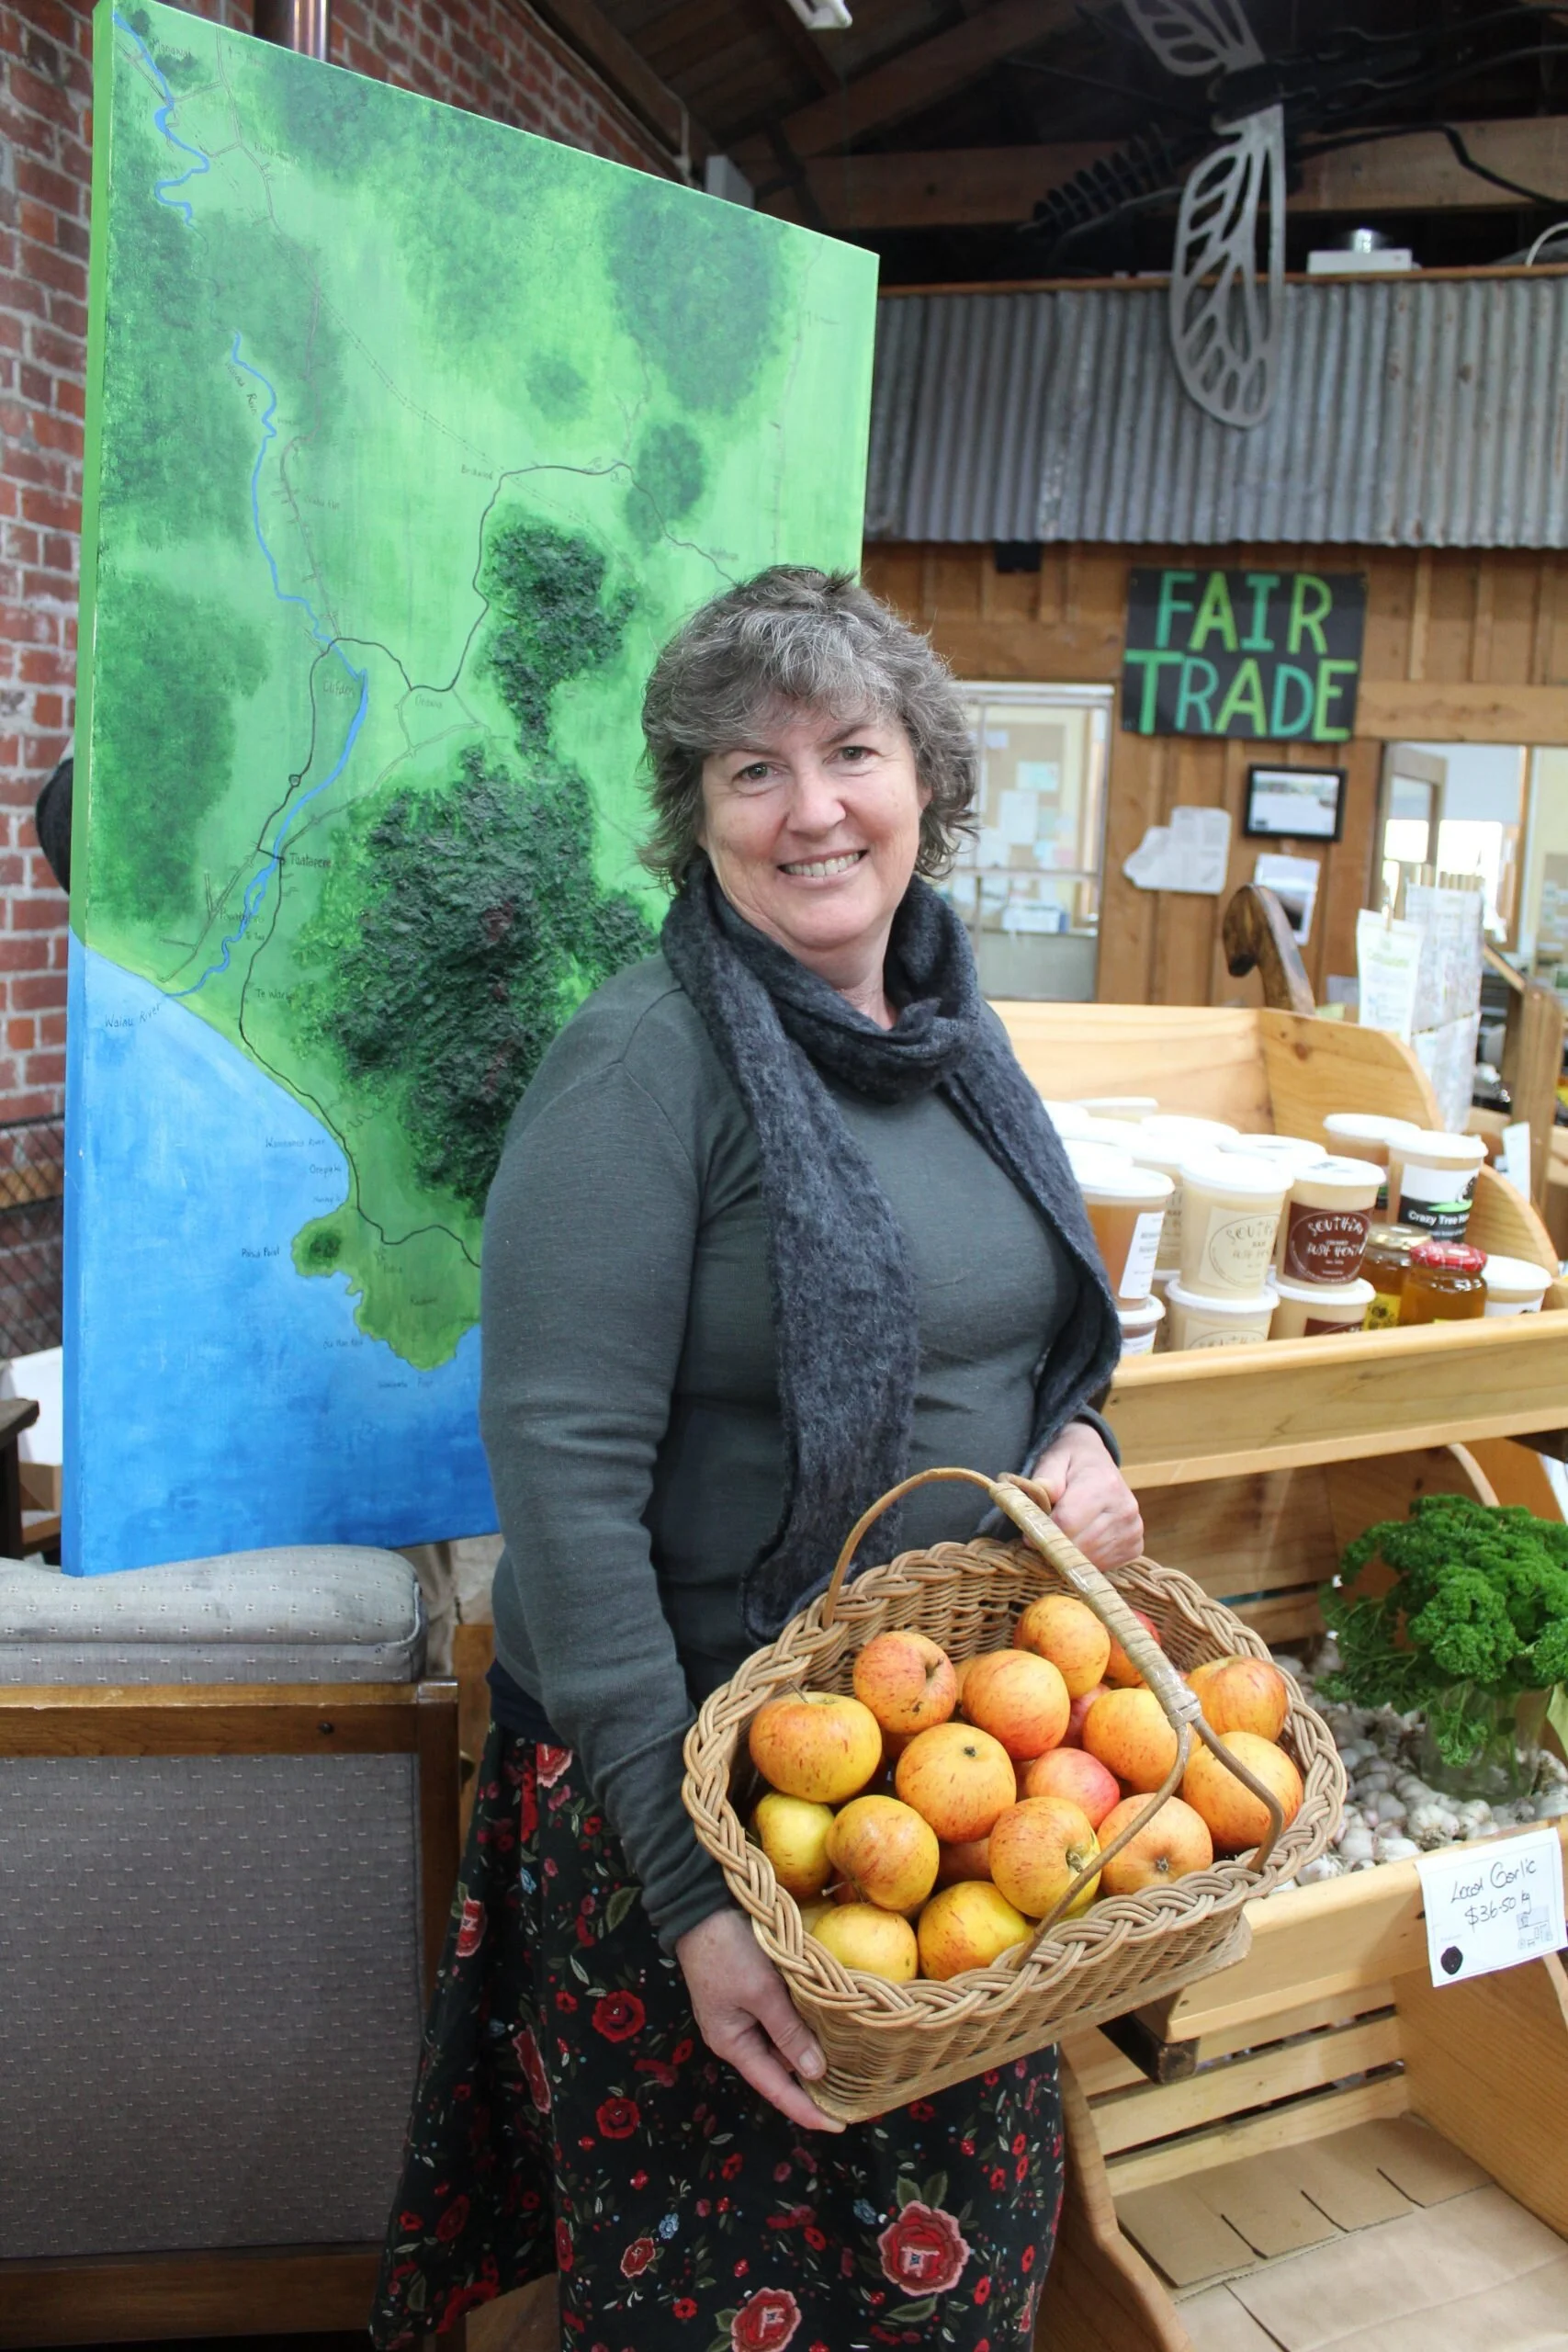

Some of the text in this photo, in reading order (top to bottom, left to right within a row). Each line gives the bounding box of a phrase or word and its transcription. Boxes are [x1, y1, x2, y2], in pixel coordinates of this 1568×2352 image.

[1156, 571, 1333, 653] FAIR
[1123, 650, 1358, 741] TRADE
[105, 1003, 161, 1028] Waiau River
[1408, 1209, 1438, 1227] Crazy
[1438, 1214, 1458, 1225] Tree
[1490, 1858, 1536, 1889] Garlic
